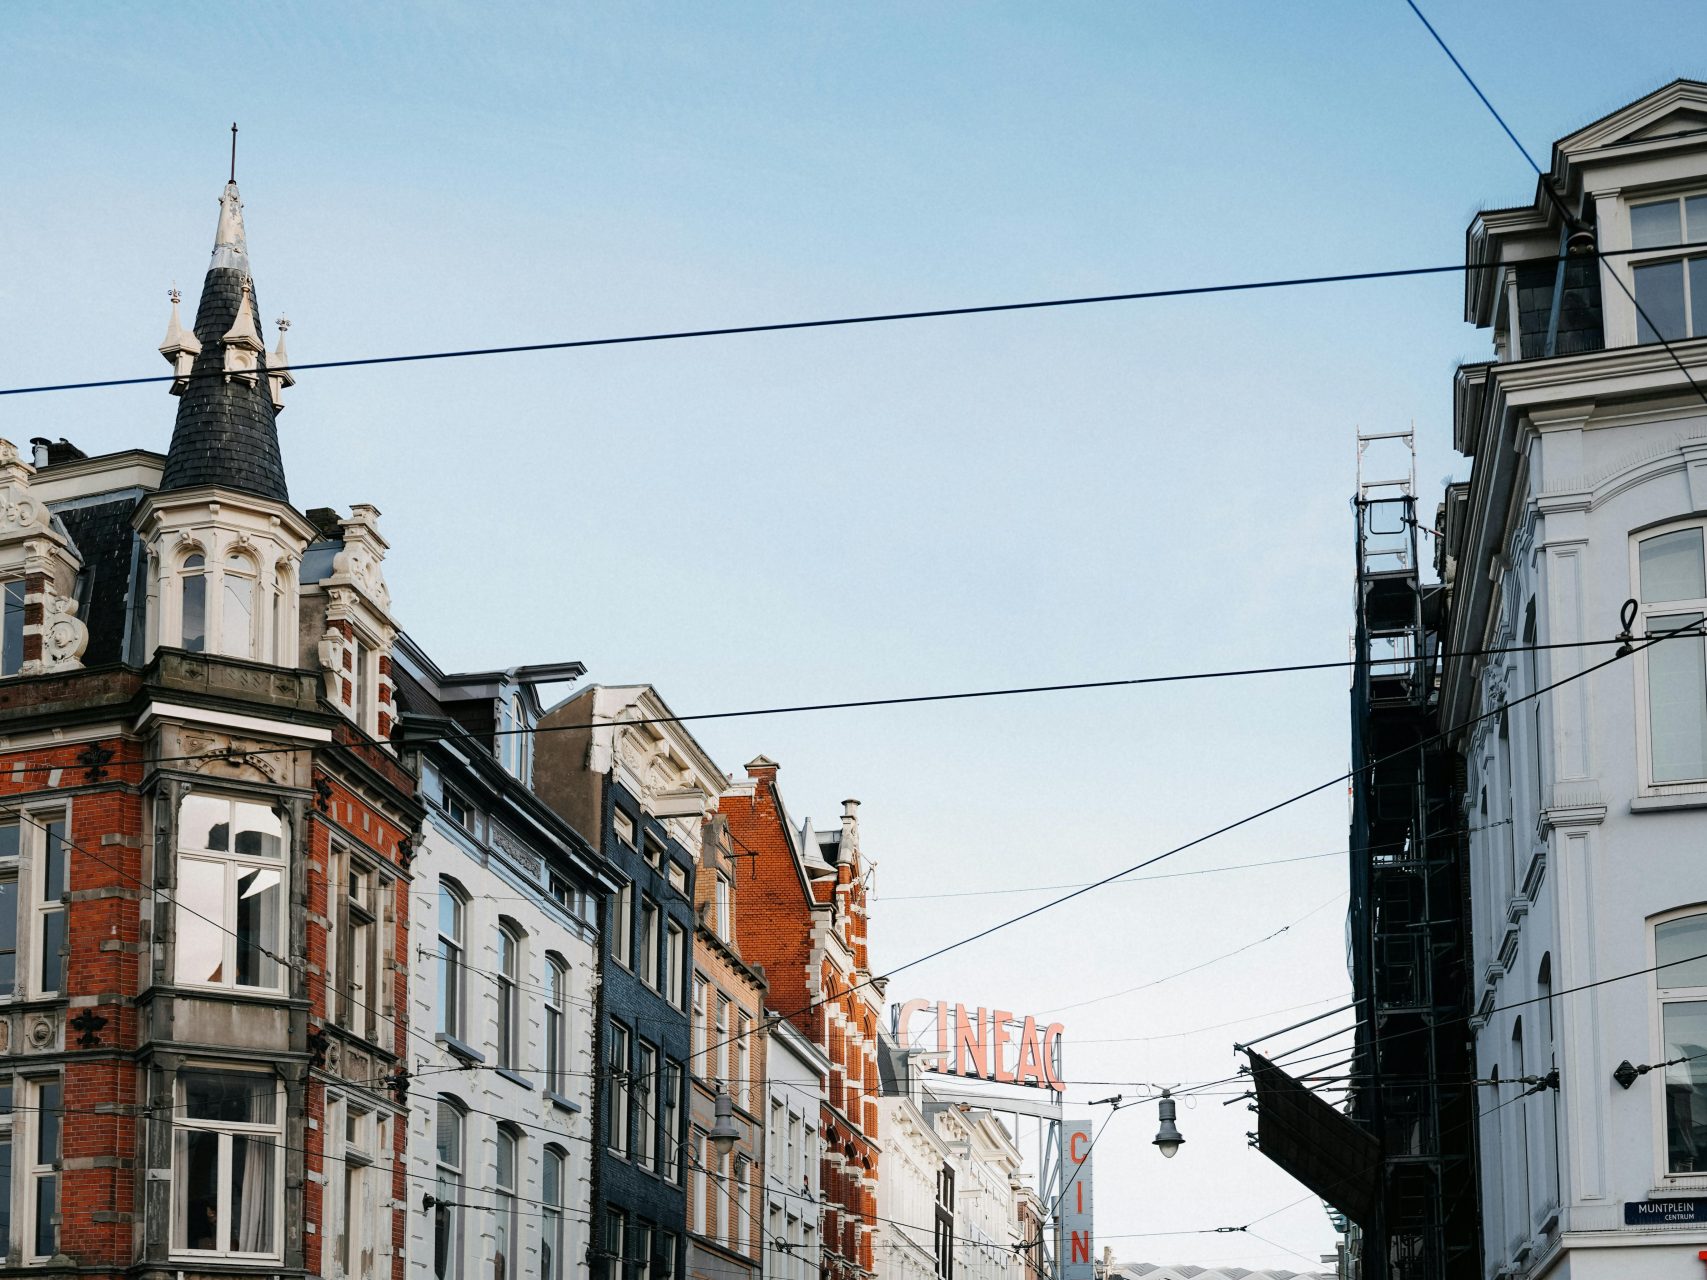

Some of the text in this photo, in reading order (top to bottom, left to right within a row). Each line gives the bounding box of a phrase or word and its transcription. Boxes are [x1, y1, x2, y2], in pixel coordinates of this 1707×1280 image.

[899, 998, 1067, 1092] CINEAC
[1638, 1202, 1695, 1214] MUNTPLEIN
[1664, 1213, 1695, 1221] CENTRUM
